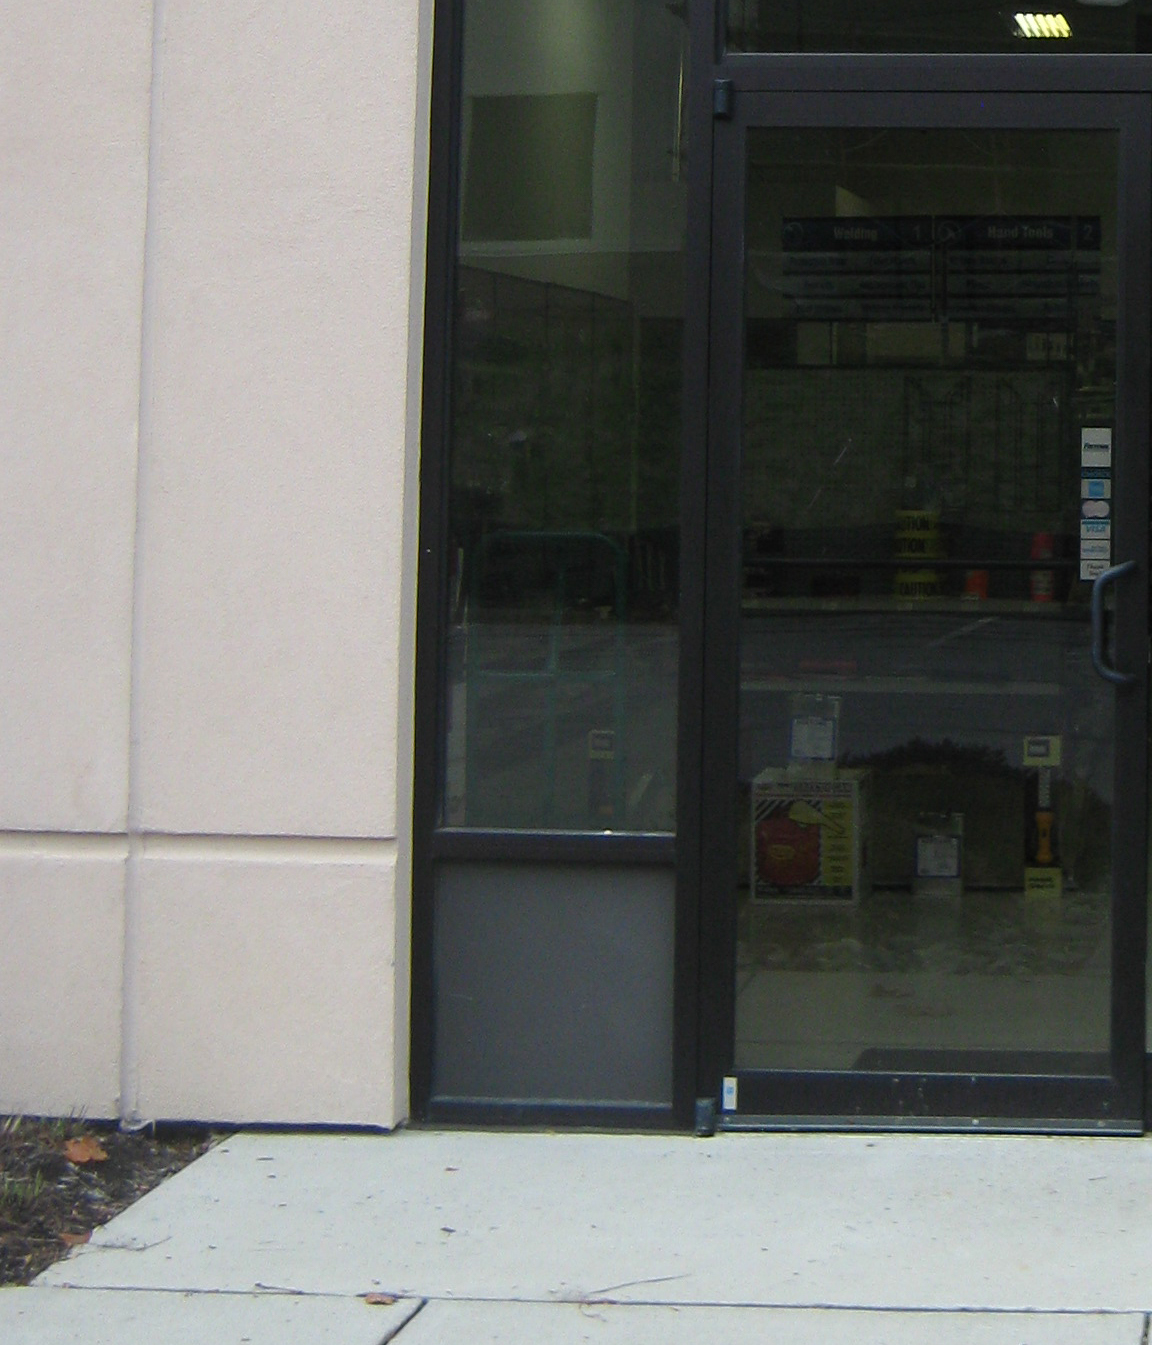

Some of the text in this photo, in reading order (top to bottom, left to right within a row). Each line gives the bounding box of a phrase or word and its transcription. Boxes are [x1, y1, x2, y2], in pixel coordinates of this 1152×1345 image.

[833, 226, 878, 241] Welding
[987, 225, 1018, 239] Hand
[1021, 225, 1054, 239] Tools
